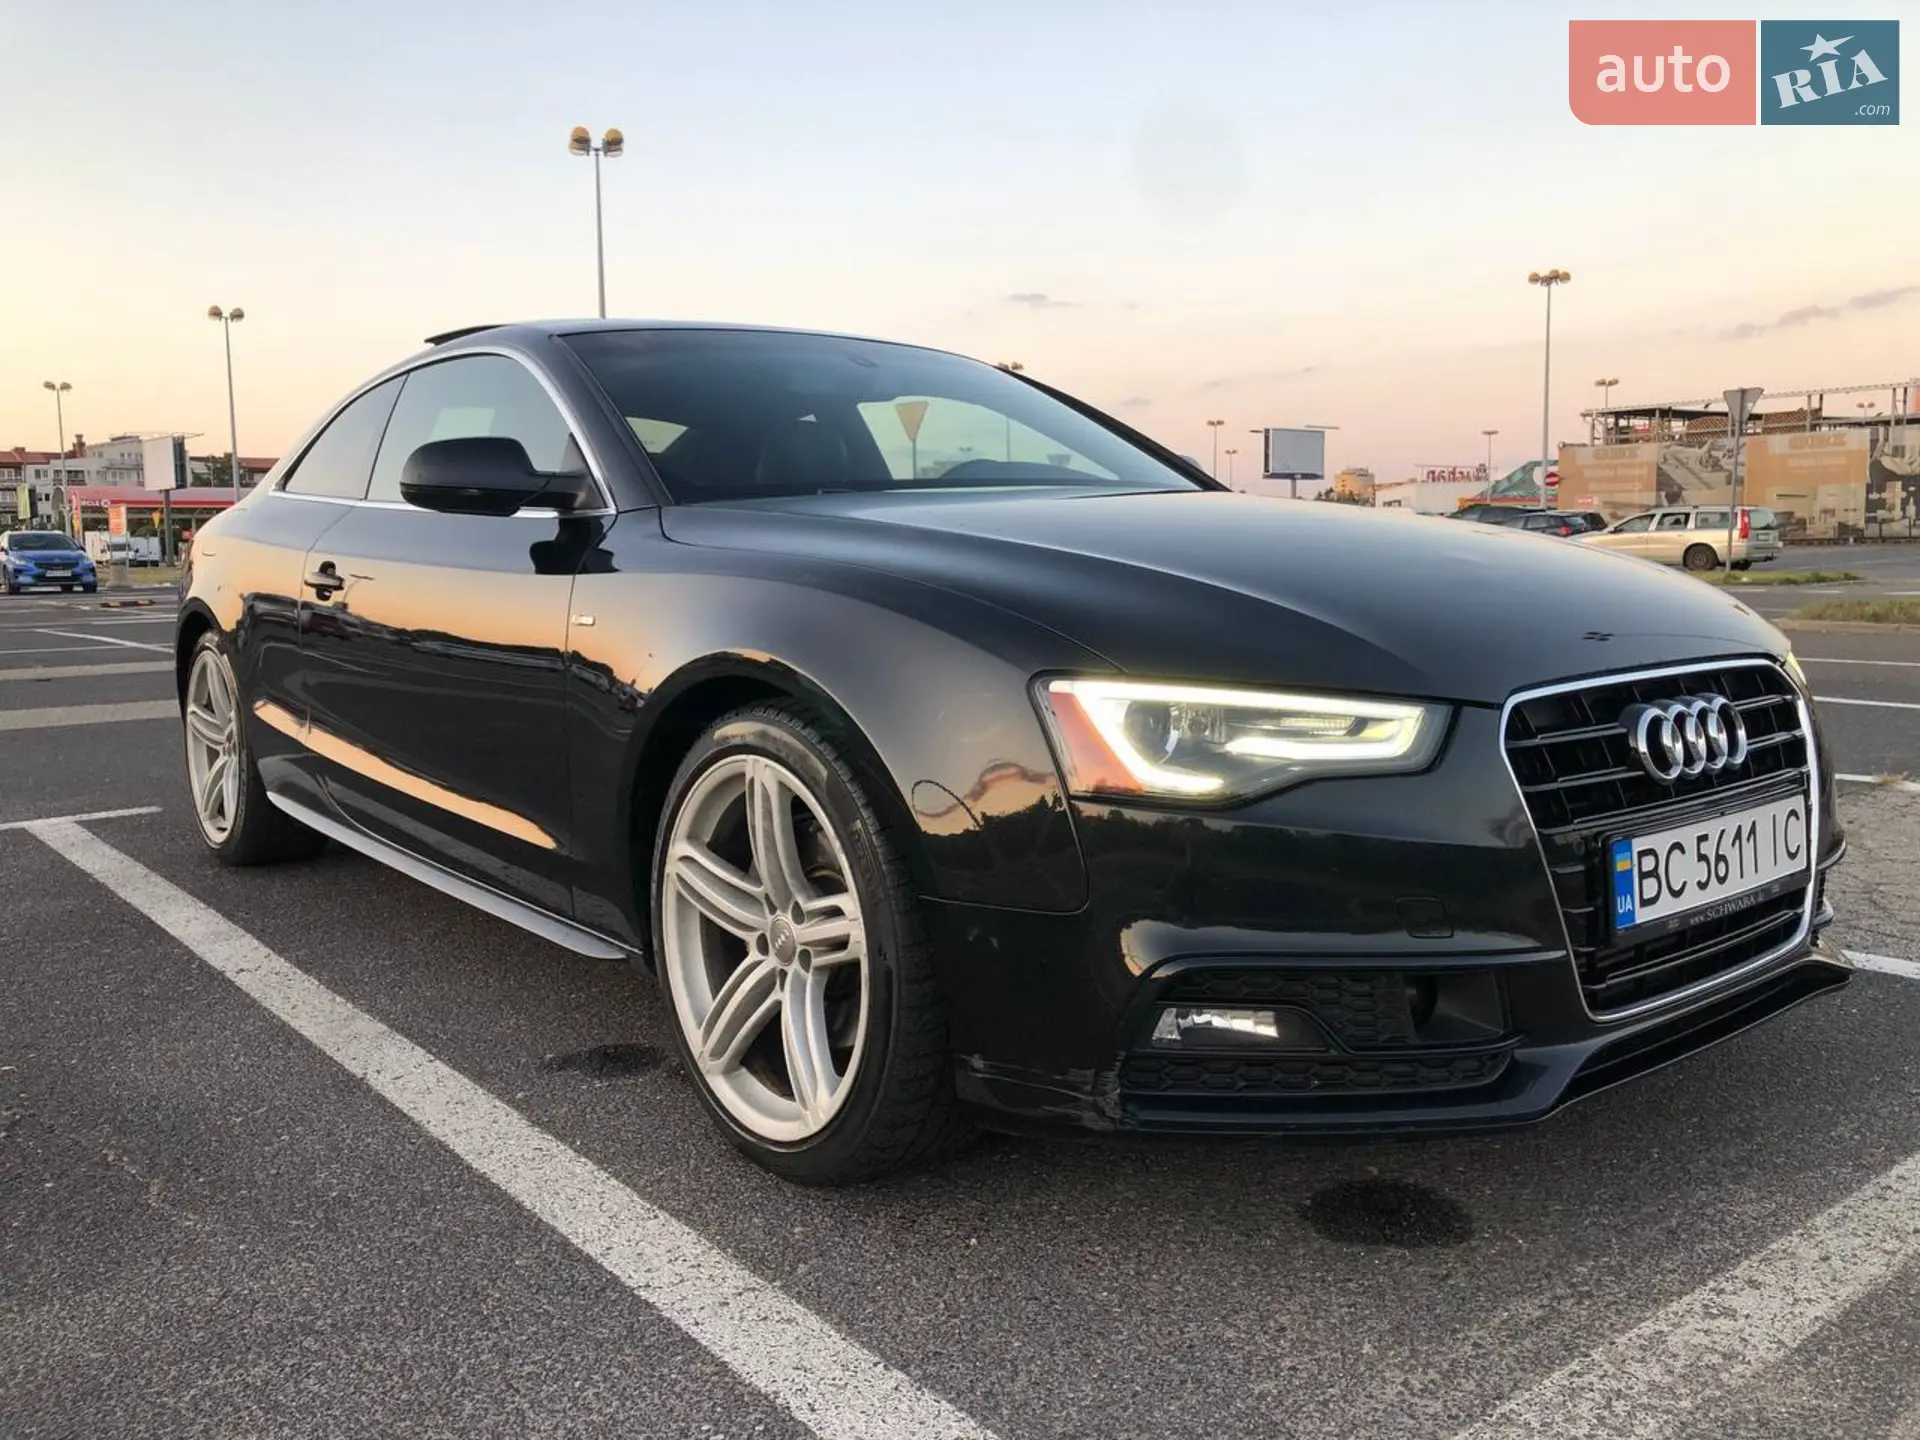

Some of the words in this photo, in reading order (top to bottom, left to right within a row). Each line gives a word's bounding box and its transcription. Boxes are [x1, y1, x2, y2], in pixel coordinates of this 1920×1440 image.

[1637, 841, 1687, 909] BC
[1696, 820, 1758, 890] 5611
[1772, 808, 1801, 866] IC
[1617, 894, 1632, 913] UA
